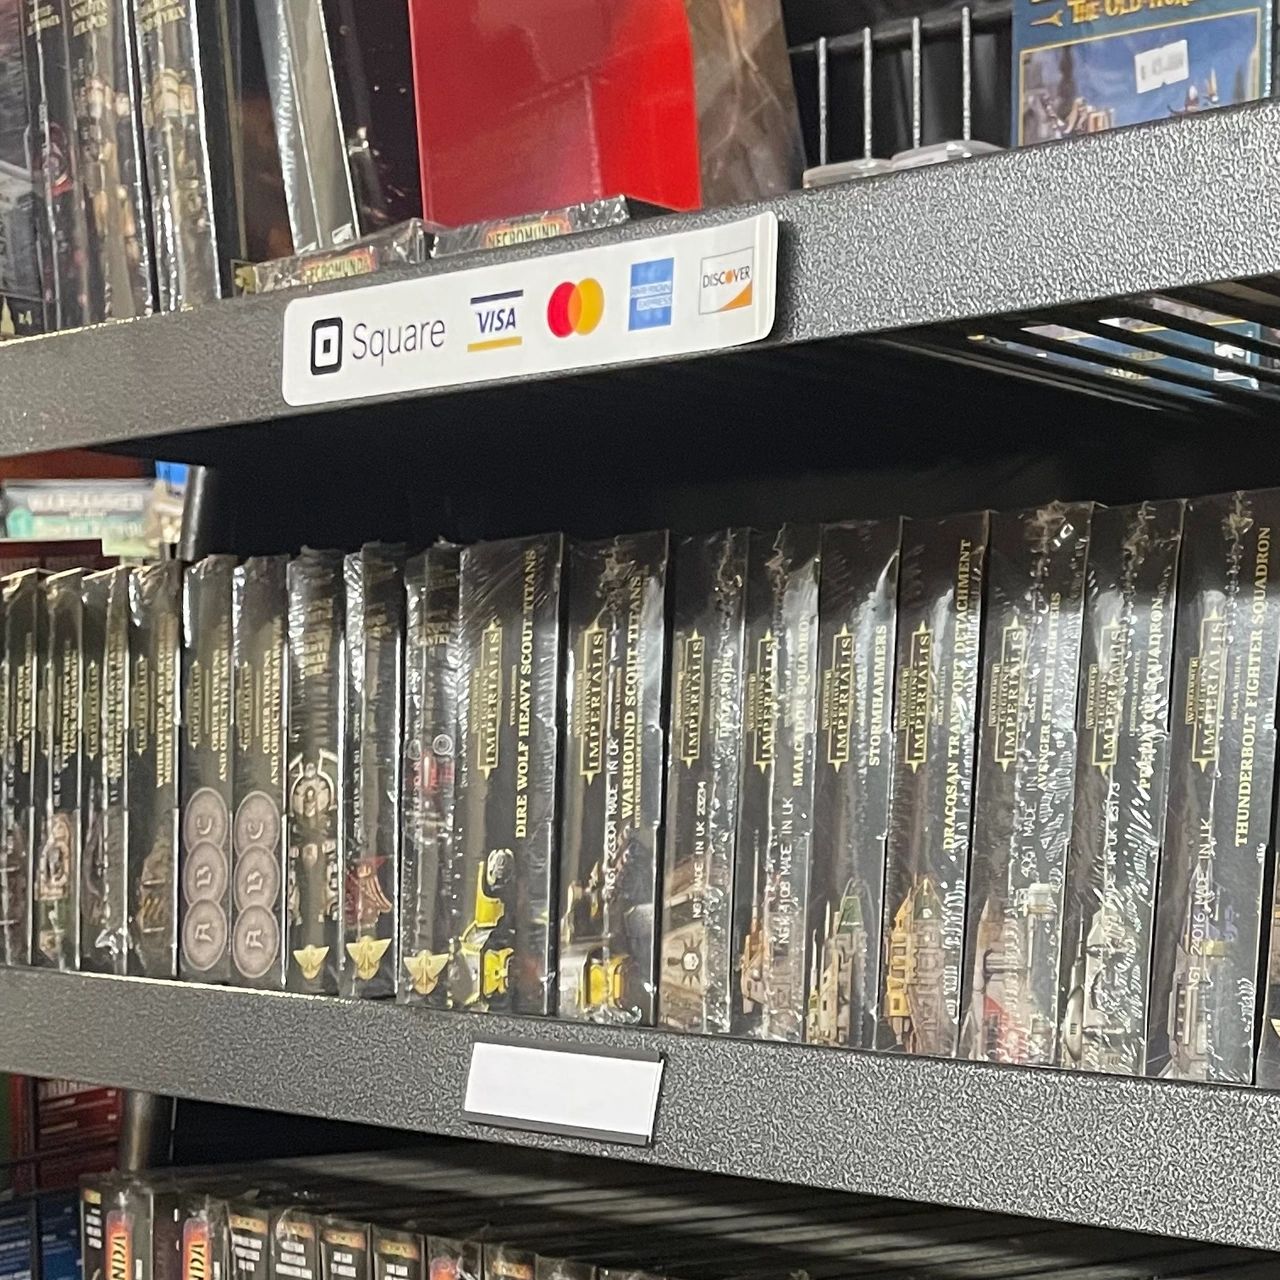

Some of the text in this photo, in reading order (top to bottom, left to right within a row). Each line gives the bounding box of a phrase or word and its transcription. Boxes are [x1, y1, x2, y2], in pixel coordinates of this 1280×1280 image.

[477, 307, 517, 334] VISA
[702, 265, 751, 289] DISCOVER
[352, 319, 446, 369] Square
[211, 649, 221, 752] ORDER TOKENS
[219, 677, 229, 782] AND OBJECTIVE
[262, 649, 272, 754] ORDER TOKENS
[270, 678, 280, 784] AND OBJECTIVE
[485, 632, 500, 763] IMPERIALIS
[515, 550, 537, 838] DIRE WOLF HEAVY SCOUT TITANS
[588, 634, 604, 768] IMPERIALIS
[621, 576, 642, 820] WARHOUND SCOUT TITANS
[687, 641, 703, 755] IMPERIALIS
[792, 611, 810, 786] MALCADOR SQUADRON
[836, 637, 852, 757] IMPERIALIS
[869, 625, 887, 766] STORMHAMMERS
[913, 634, 930, 758] IMPERIALIS
[943, 539, 972, 849] DRACOSAN TRANSPORT DETACHMENT
[1003, 630, 1024, 757] IMPERIALIS
[1037, 591, 1062, 791] AVENGER STRIKE FIGHTERS
[1200, 621, 1222, 755] IMPERIALIS
[1234, 527, 1270, 846] THUNDERBOLT FIGHTER SQUADRON
[607, 738, 619, 815] MADE IN UK
[1022, 776, 1038, 837] MADE IN
[194, 865, 213, 888] B
[245, 870, 264, 894] B
[695, 820, 706, 855] IN UK
[780, 796, 794, 875] MADE IN UK
[1190, 844, 1211, 956] 24016 MADE IN
